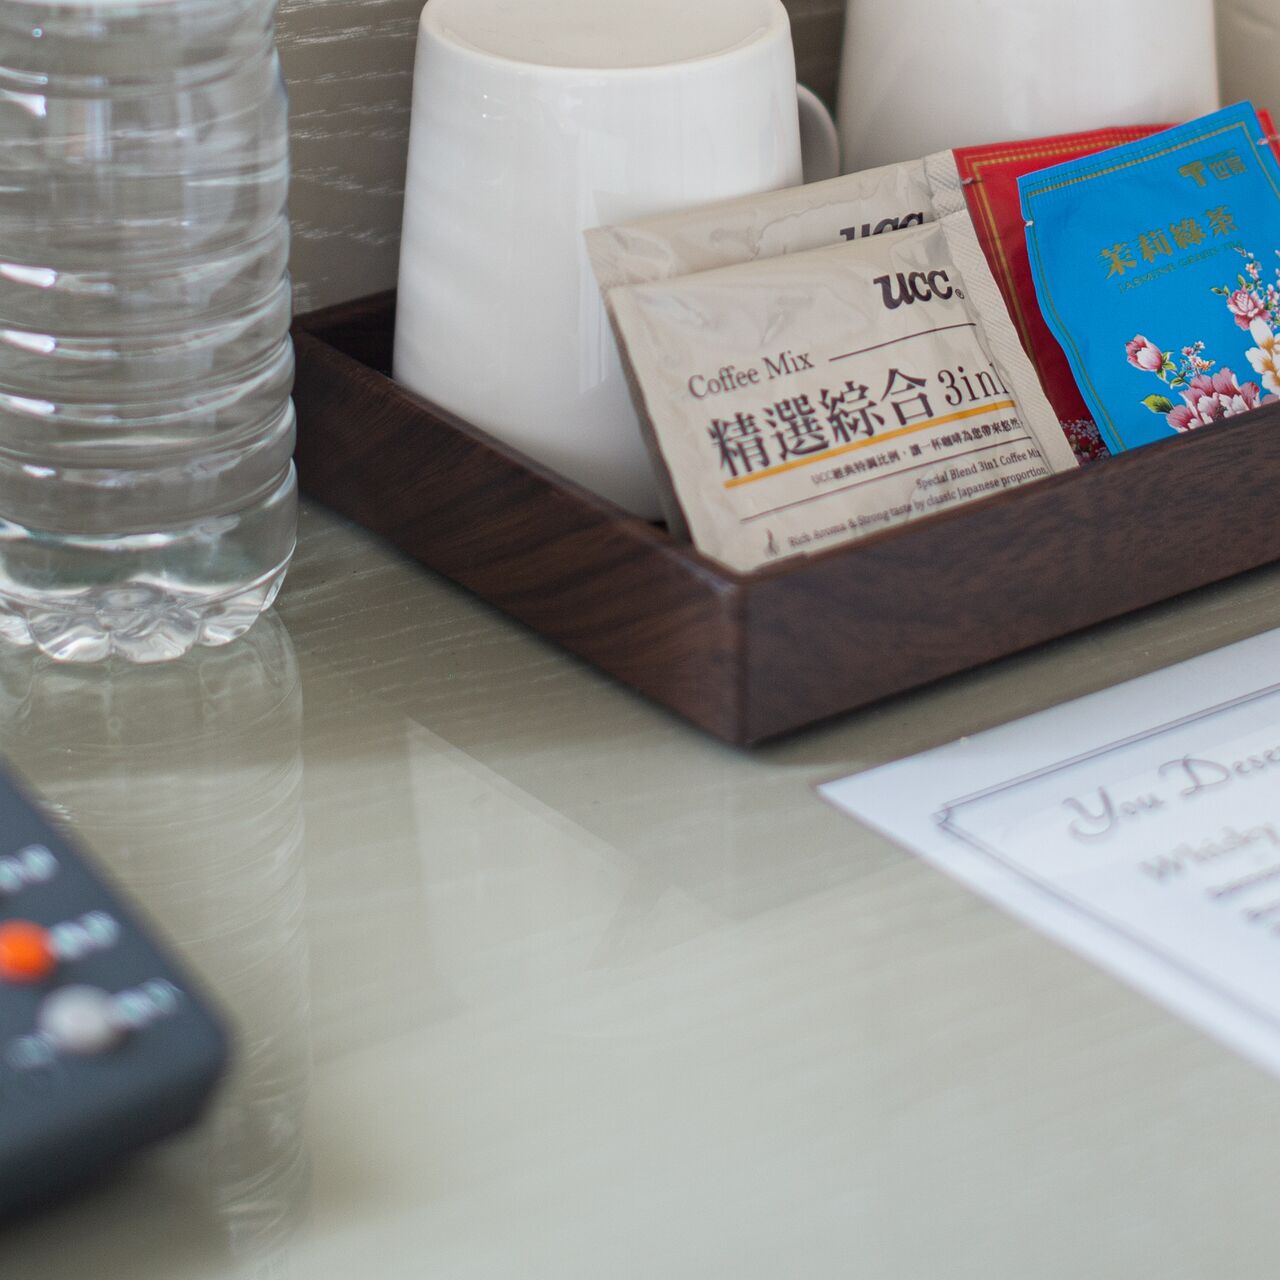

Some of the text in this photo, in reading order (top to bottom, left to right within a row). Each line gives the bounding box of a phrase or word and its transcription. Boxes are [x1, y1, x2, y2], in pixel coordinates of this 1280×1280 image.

[688, 350, 815, 400] Coffee Mix
[707, 367, 935, 477] 精選綜合
[916, 471, 949, 489] Special
[950, 461, 978, 480] Blend
[979, 458, 999, 472] 3in1
[999, 451, 1028, 467] Coffee
[913, 500, 925, 512] by
[926, 490, 957, 507] classic
[958, 479, 1000, 500] Japanese
[1062, 786, 1165, 843] You
